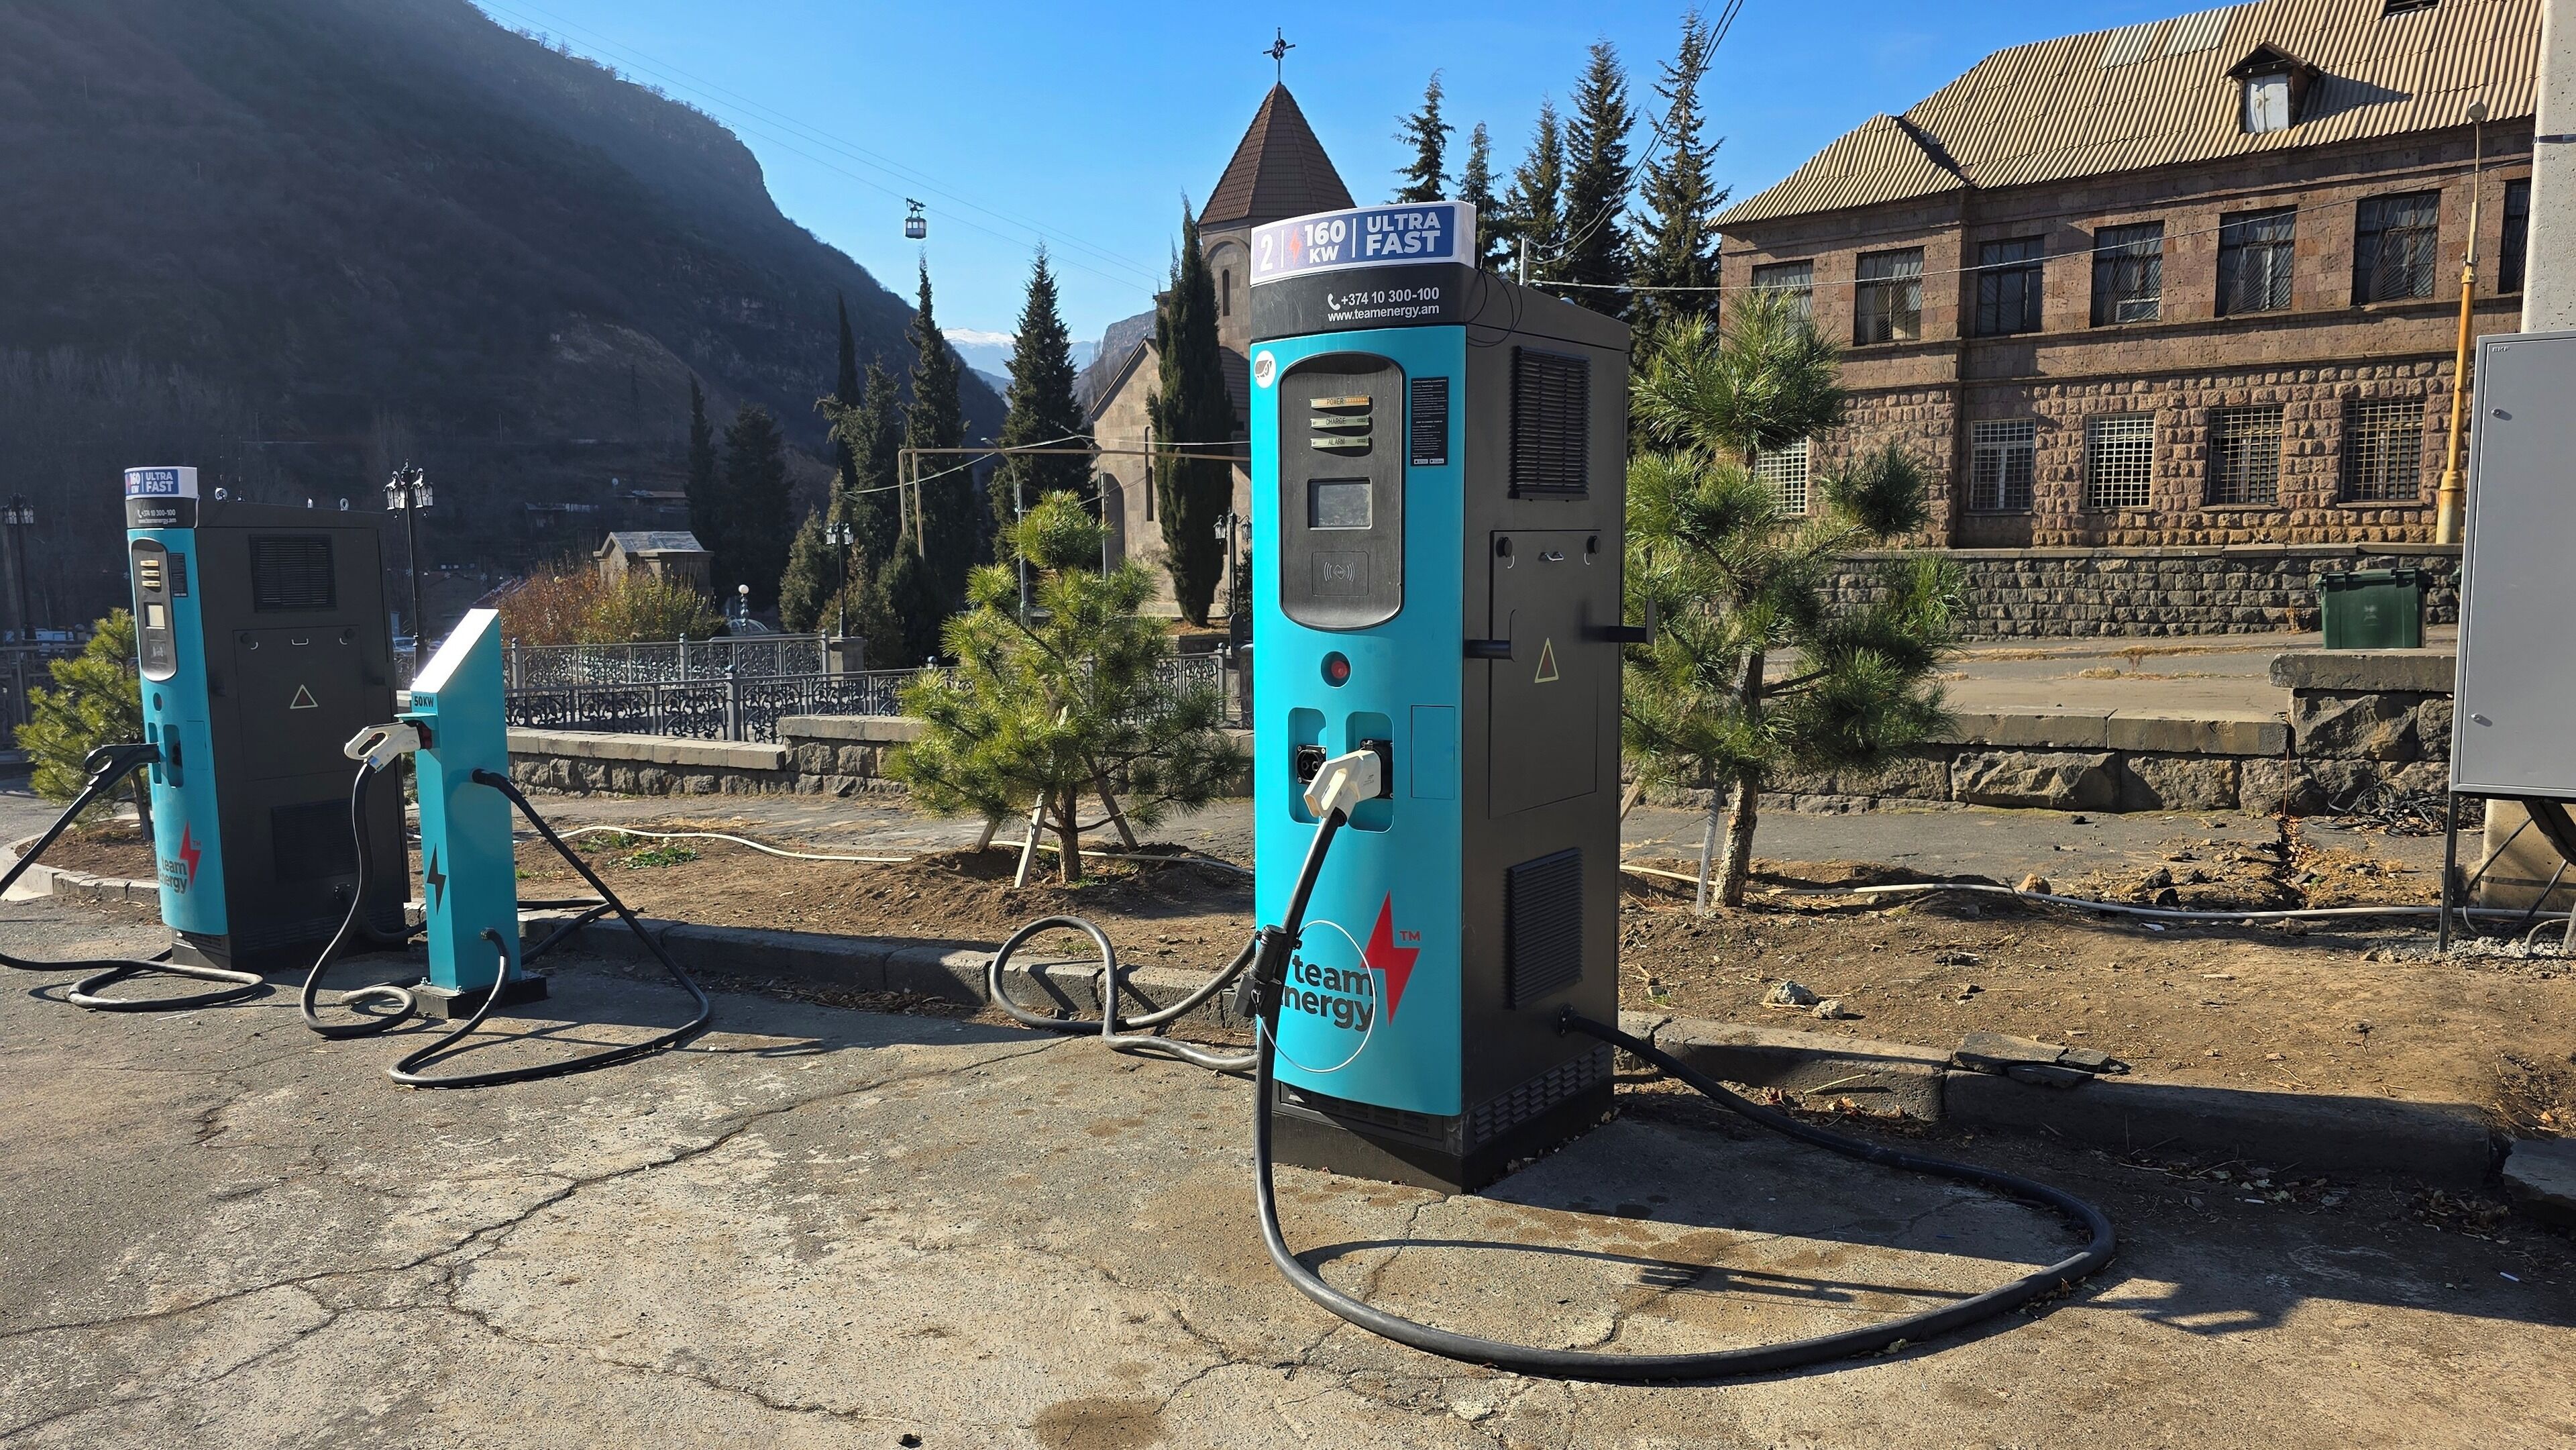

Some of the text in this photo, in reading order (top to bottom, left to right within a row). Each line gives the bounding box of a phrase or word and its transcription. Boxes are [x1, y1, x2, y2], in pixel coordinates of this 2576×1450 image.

[1366, 211, 1441, 234] ULTRA
[1304, 219, 1346, 248] 160
[1366, 229, 1441, 256] FAST
[1260, 234, 1273, 271] 2
[1309, 244, 1340, 264] KW
[1341, 287, 1440, 307] +374 10 300-100
[1328, 304, 1440, 322] www.teamenergy.am
[1327, 398, 1344, 406] POWER
[1326, 417, 1346, 425] CHARGE
[146, 472, 173, 480] ULTRA
[146, 480, 174, 492] FAST
[414, 696, 434, 708] 50KW
[162, 856, 188, 876] team
[1399, 930, 1421, 941] TM
[1292, 954, 1378, 998] team
[1281, 986, 1377, 1032] nergy
